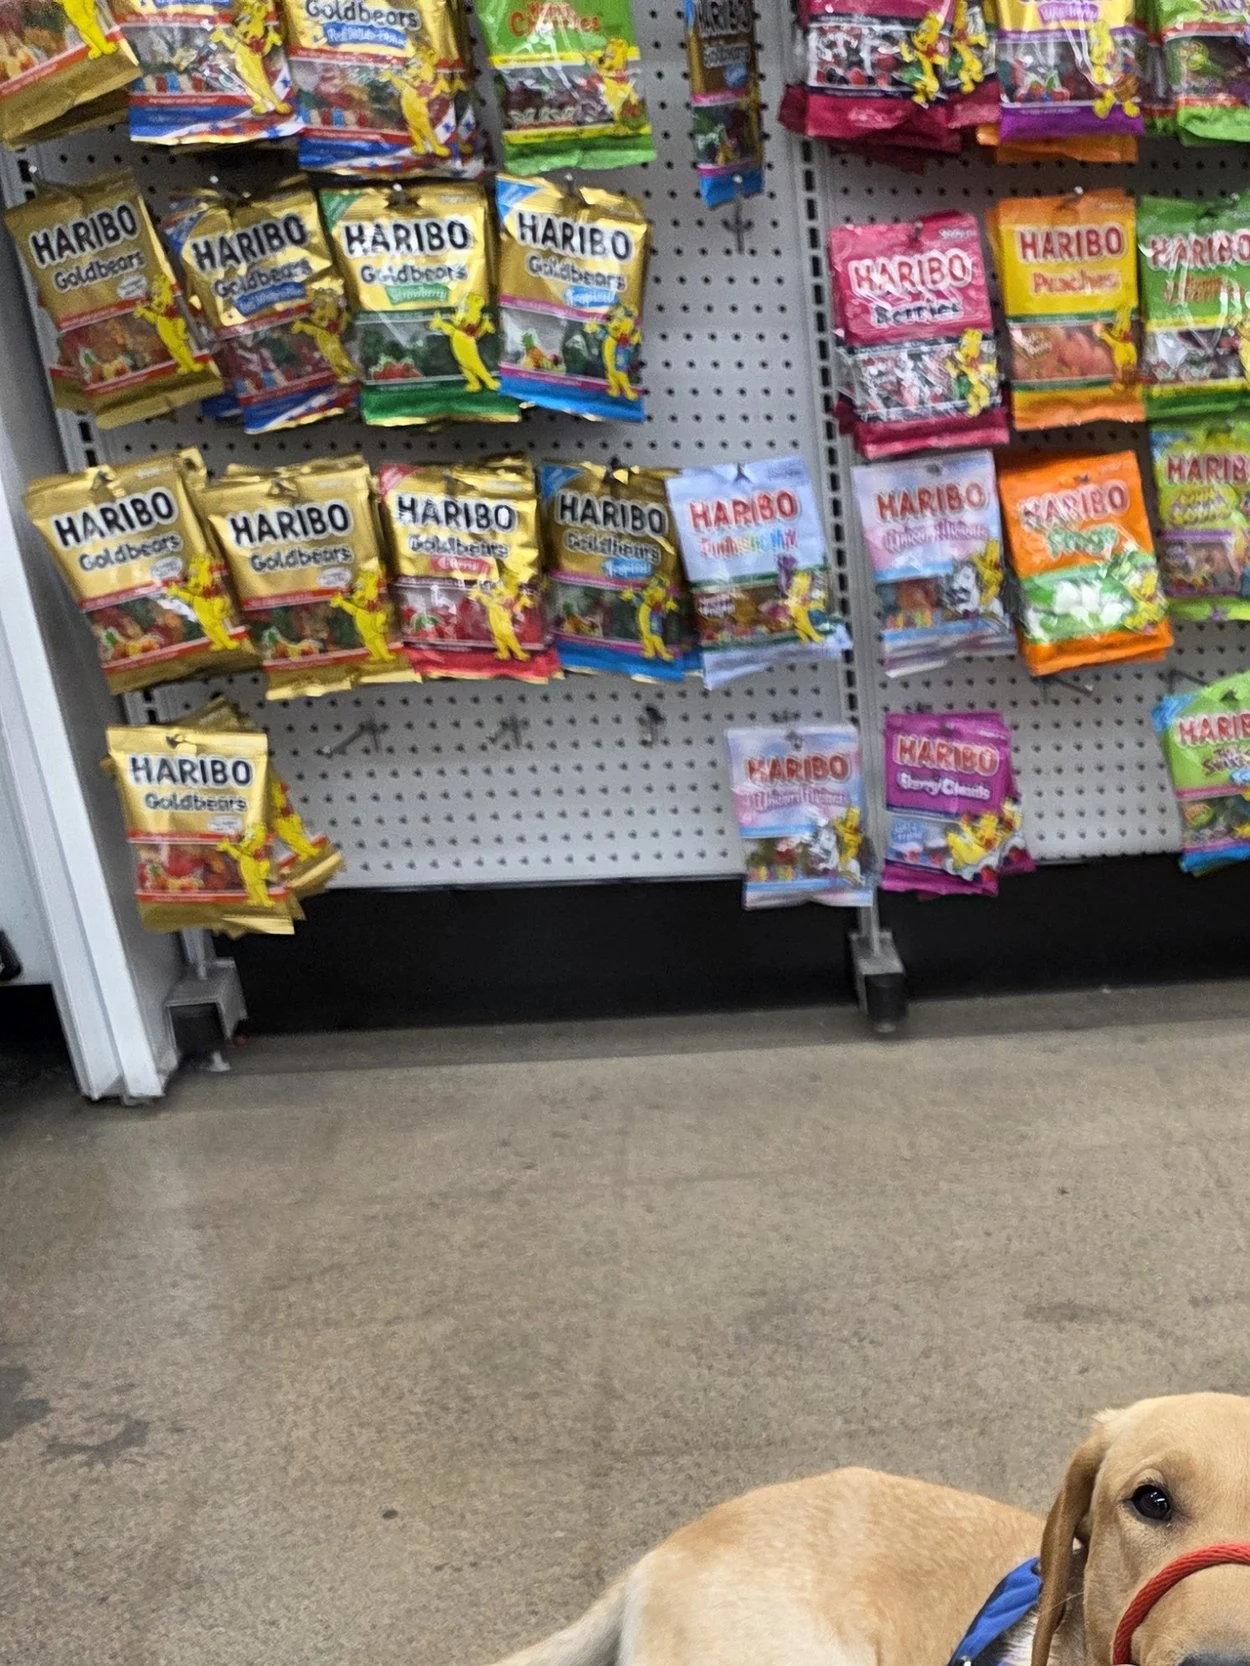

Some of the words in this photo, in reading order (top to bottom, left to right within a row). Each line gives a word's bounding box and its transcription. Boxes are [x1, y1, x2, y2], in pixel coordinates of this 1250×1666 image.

[306, 0, 420, 30] Goldbears
[30, 203, 138, 265] HARIBO
[191, 214, 308, 270] HARIBO
[343, 219, 469, 255] HARIBO
[518, 212, 632, 261] HARIBO
[1020, 226, 1123, 260] HARIBO
[53, 250, 146, 291] Goldbears
[213, 259, 313, 298] Goldbears
[360, 264, 468, 284] Goldbears
[527, 255, 626, 291] Goldbears
[853, 252, 970, 291] HARIBO
[54, 490, 175, 548] HARIBO
[397, 494, 517, 531] HARIBO
[556, 494, 668, 536] HARIBO
[688, 489, 799, 529] HARIBO
[876, 482, 987, 522] HARIBO
[1020, 481, 1129, 526] HARIBO
[229, 502, 350, 545] HARIBO
[79, 537, 181, 572] Goldbears
[250, 546, 354, 573] Goldbears
[408, 535, 511, 560] Goldbears
[566, 531, 662, 562] Goldbears
[130, 757, 252, 785] HARIBO
[747, 753, 850, 783] HARIBO
[898, 737, 999, 775] HARIBO
[143, 791, 248, 812] Goldbears
